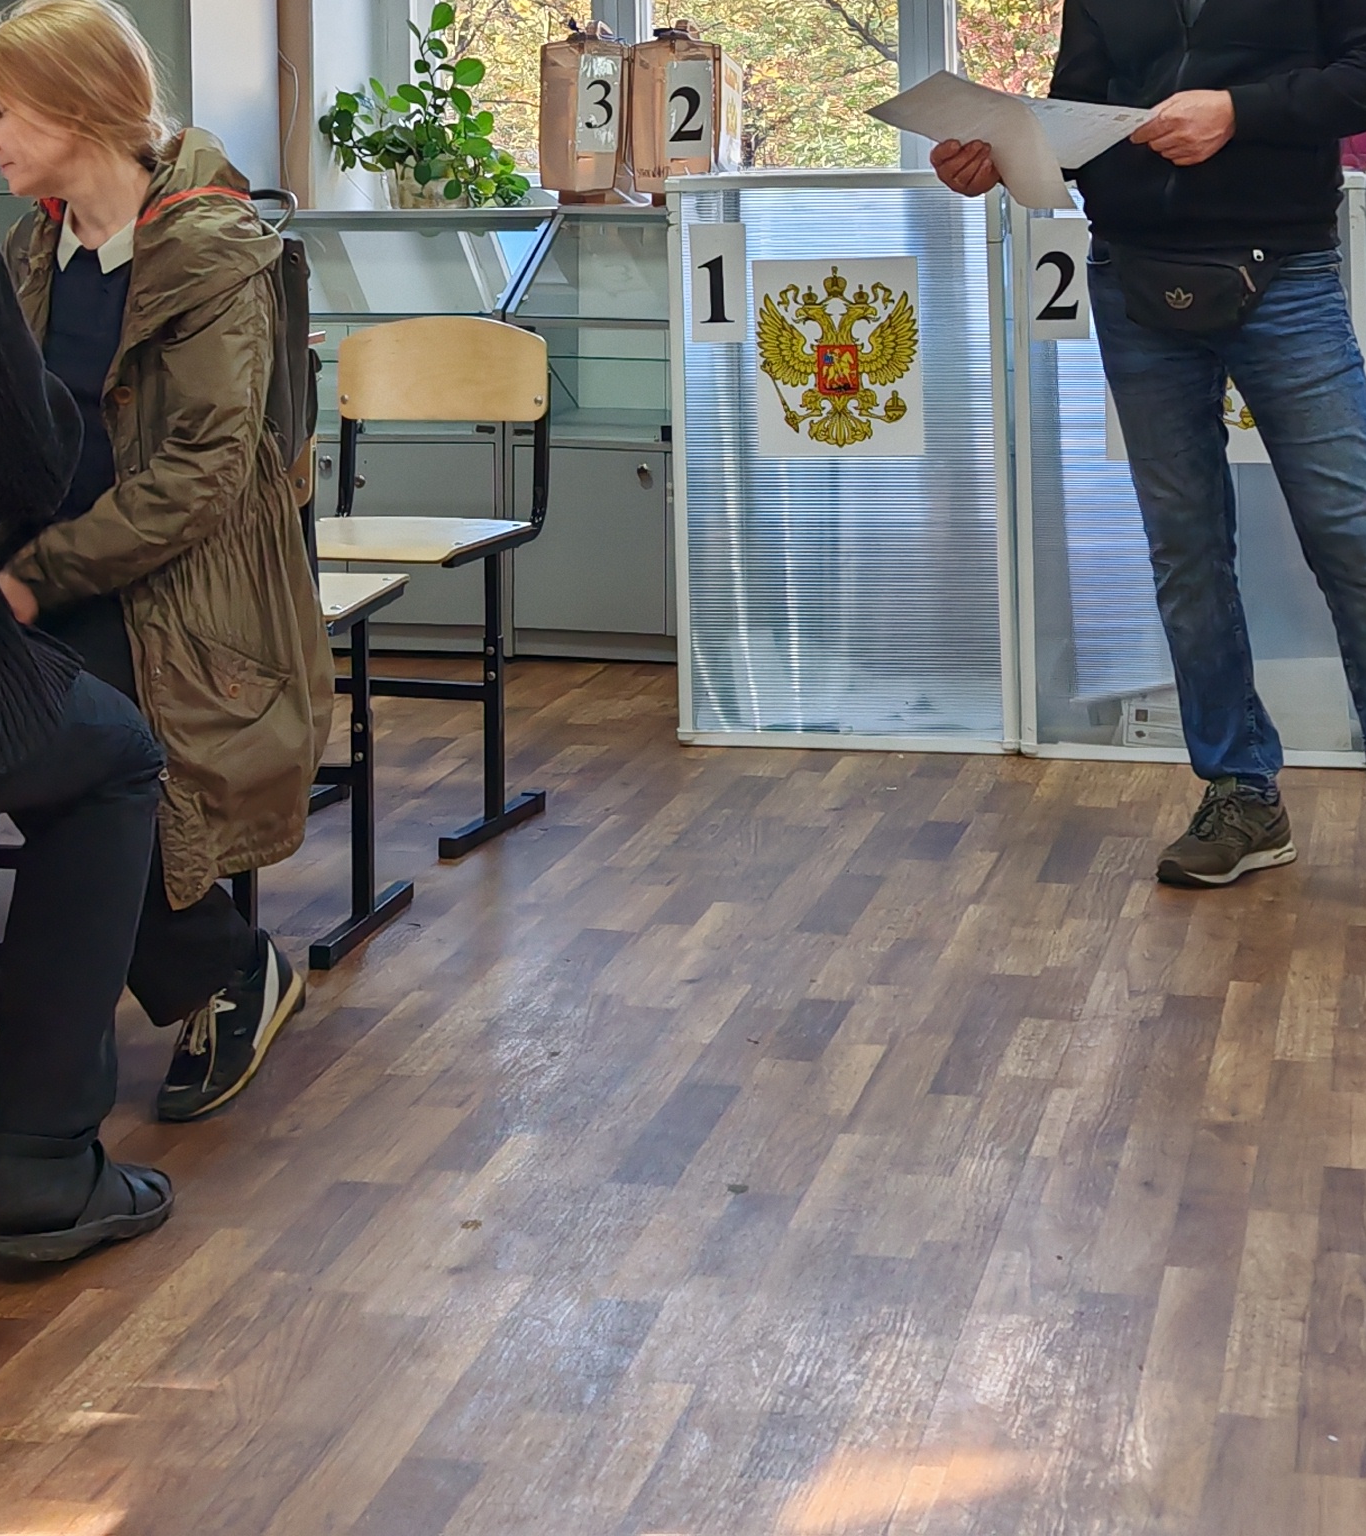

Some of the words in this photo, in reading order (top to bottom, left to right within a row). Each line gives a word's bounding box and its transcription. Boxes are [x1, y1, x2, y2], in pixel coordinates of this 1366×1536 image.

[584, 79, 613, 129] 3
[668, 86, 704, 142] 2
[697, 254, 735, 324] 1
[1035, 251, 1080, 321] 2
